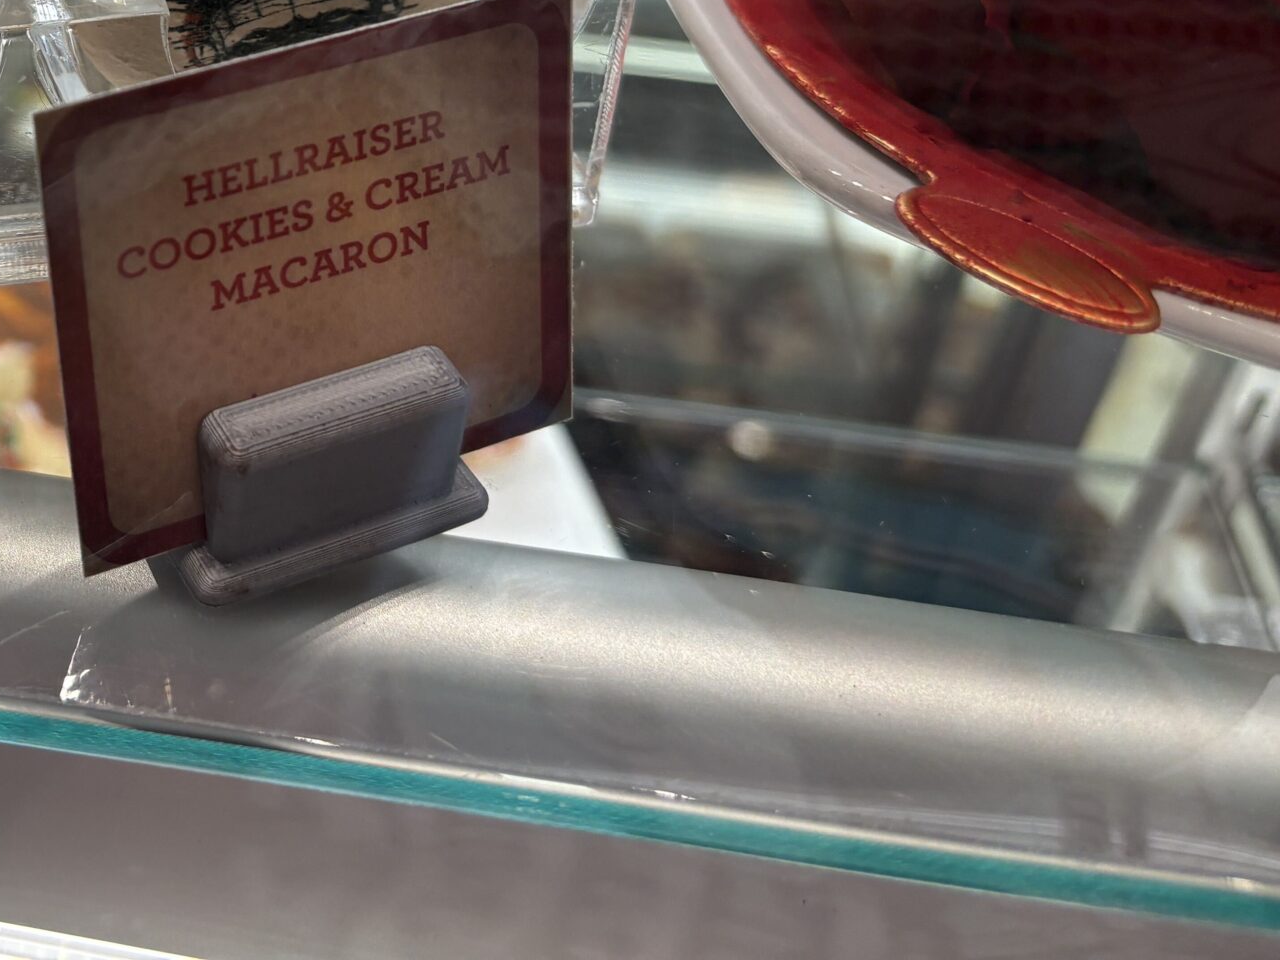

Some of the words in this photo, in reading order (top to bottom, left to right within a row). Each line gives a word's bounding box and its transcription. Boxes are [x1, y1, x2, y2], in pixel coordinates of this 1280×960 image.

[183, 110, 445, 207] HELLRAISER
[117, 200, 314, 278] COOKIES
[326, 191, 354, 223] &
[365, 145, 510, 210] CREAM
[210, 221, 430, 311] MACARON
